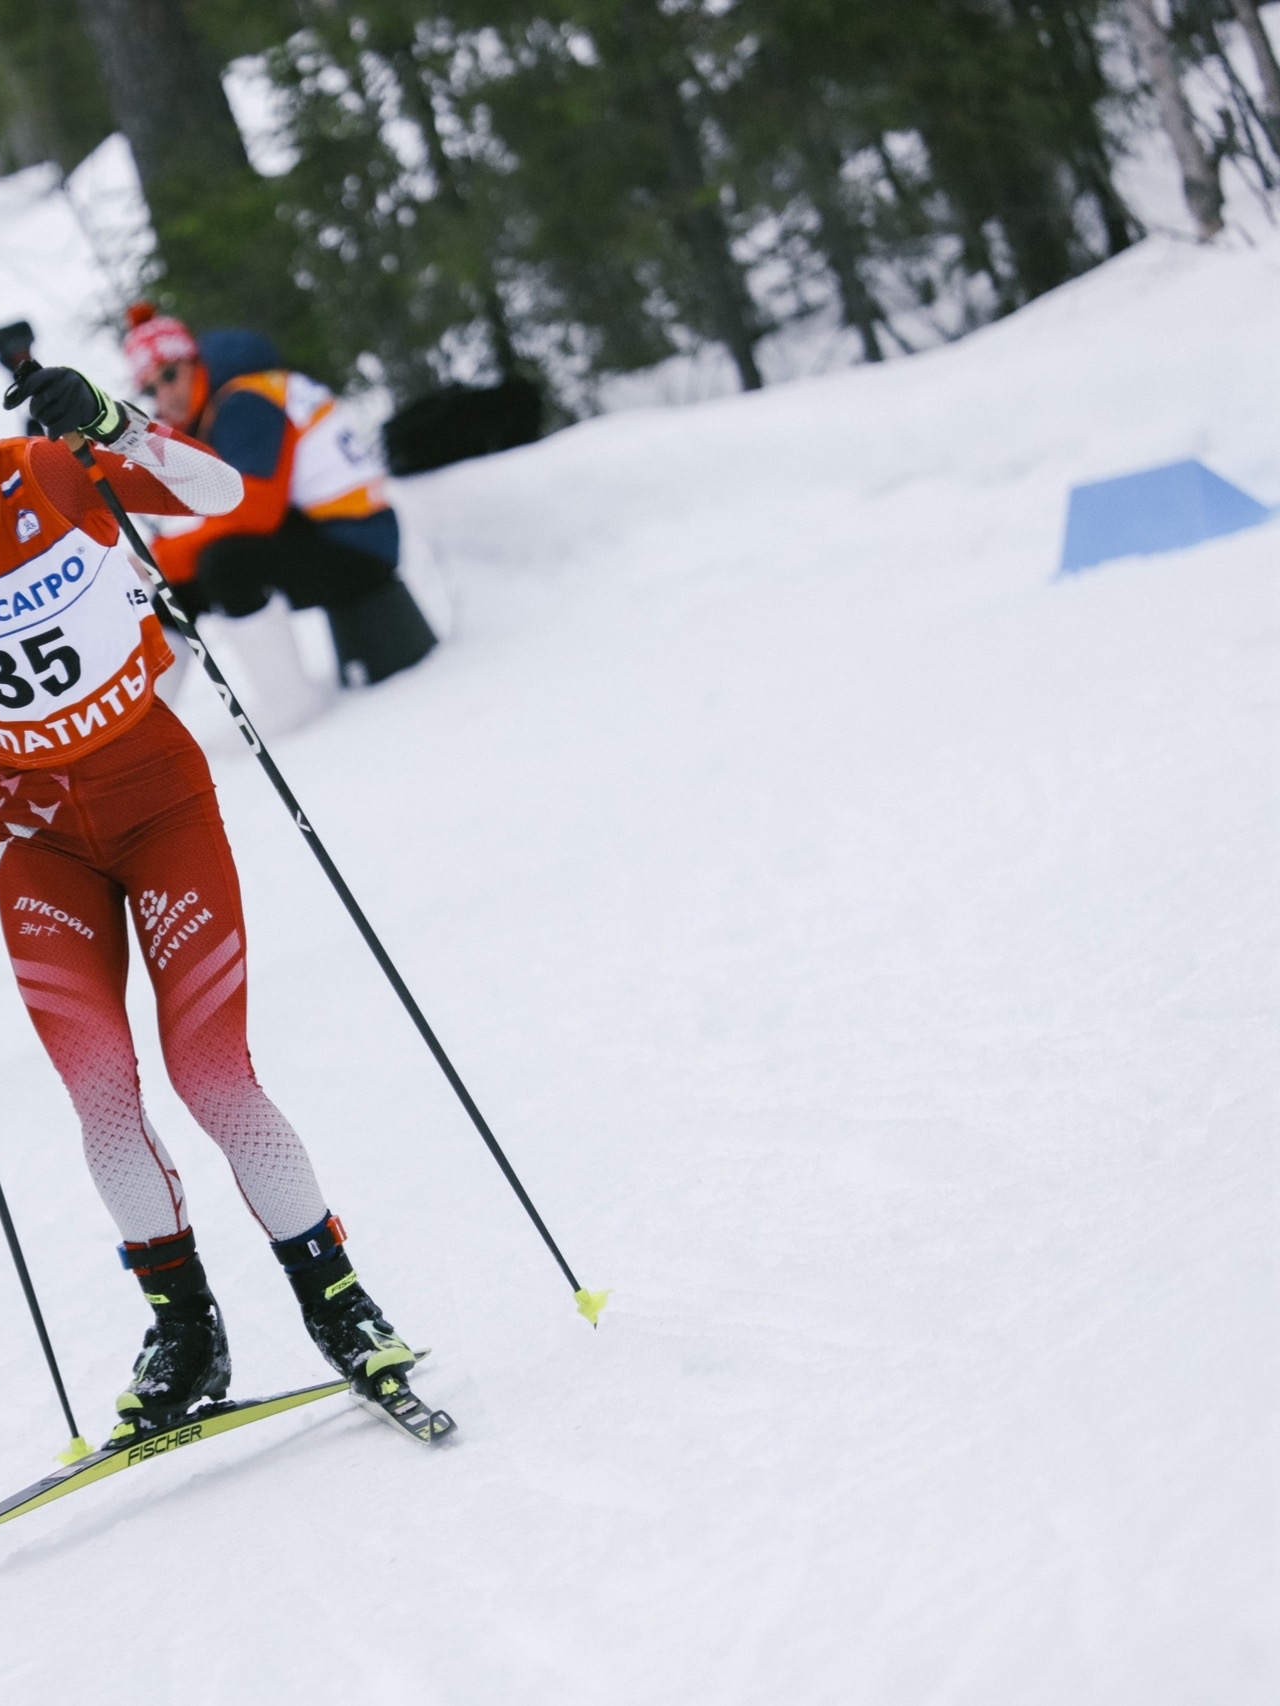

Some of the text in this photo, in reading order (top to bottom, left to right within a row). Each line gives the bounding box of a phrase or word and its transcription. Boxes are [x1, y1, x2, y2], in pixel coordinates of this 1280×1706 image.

[13, 896, 95, 940] ЛУКОЙЛ
[158, 908, 213, 970] BIVIUM
[128, 1424, 202, 1466] FISCHER
